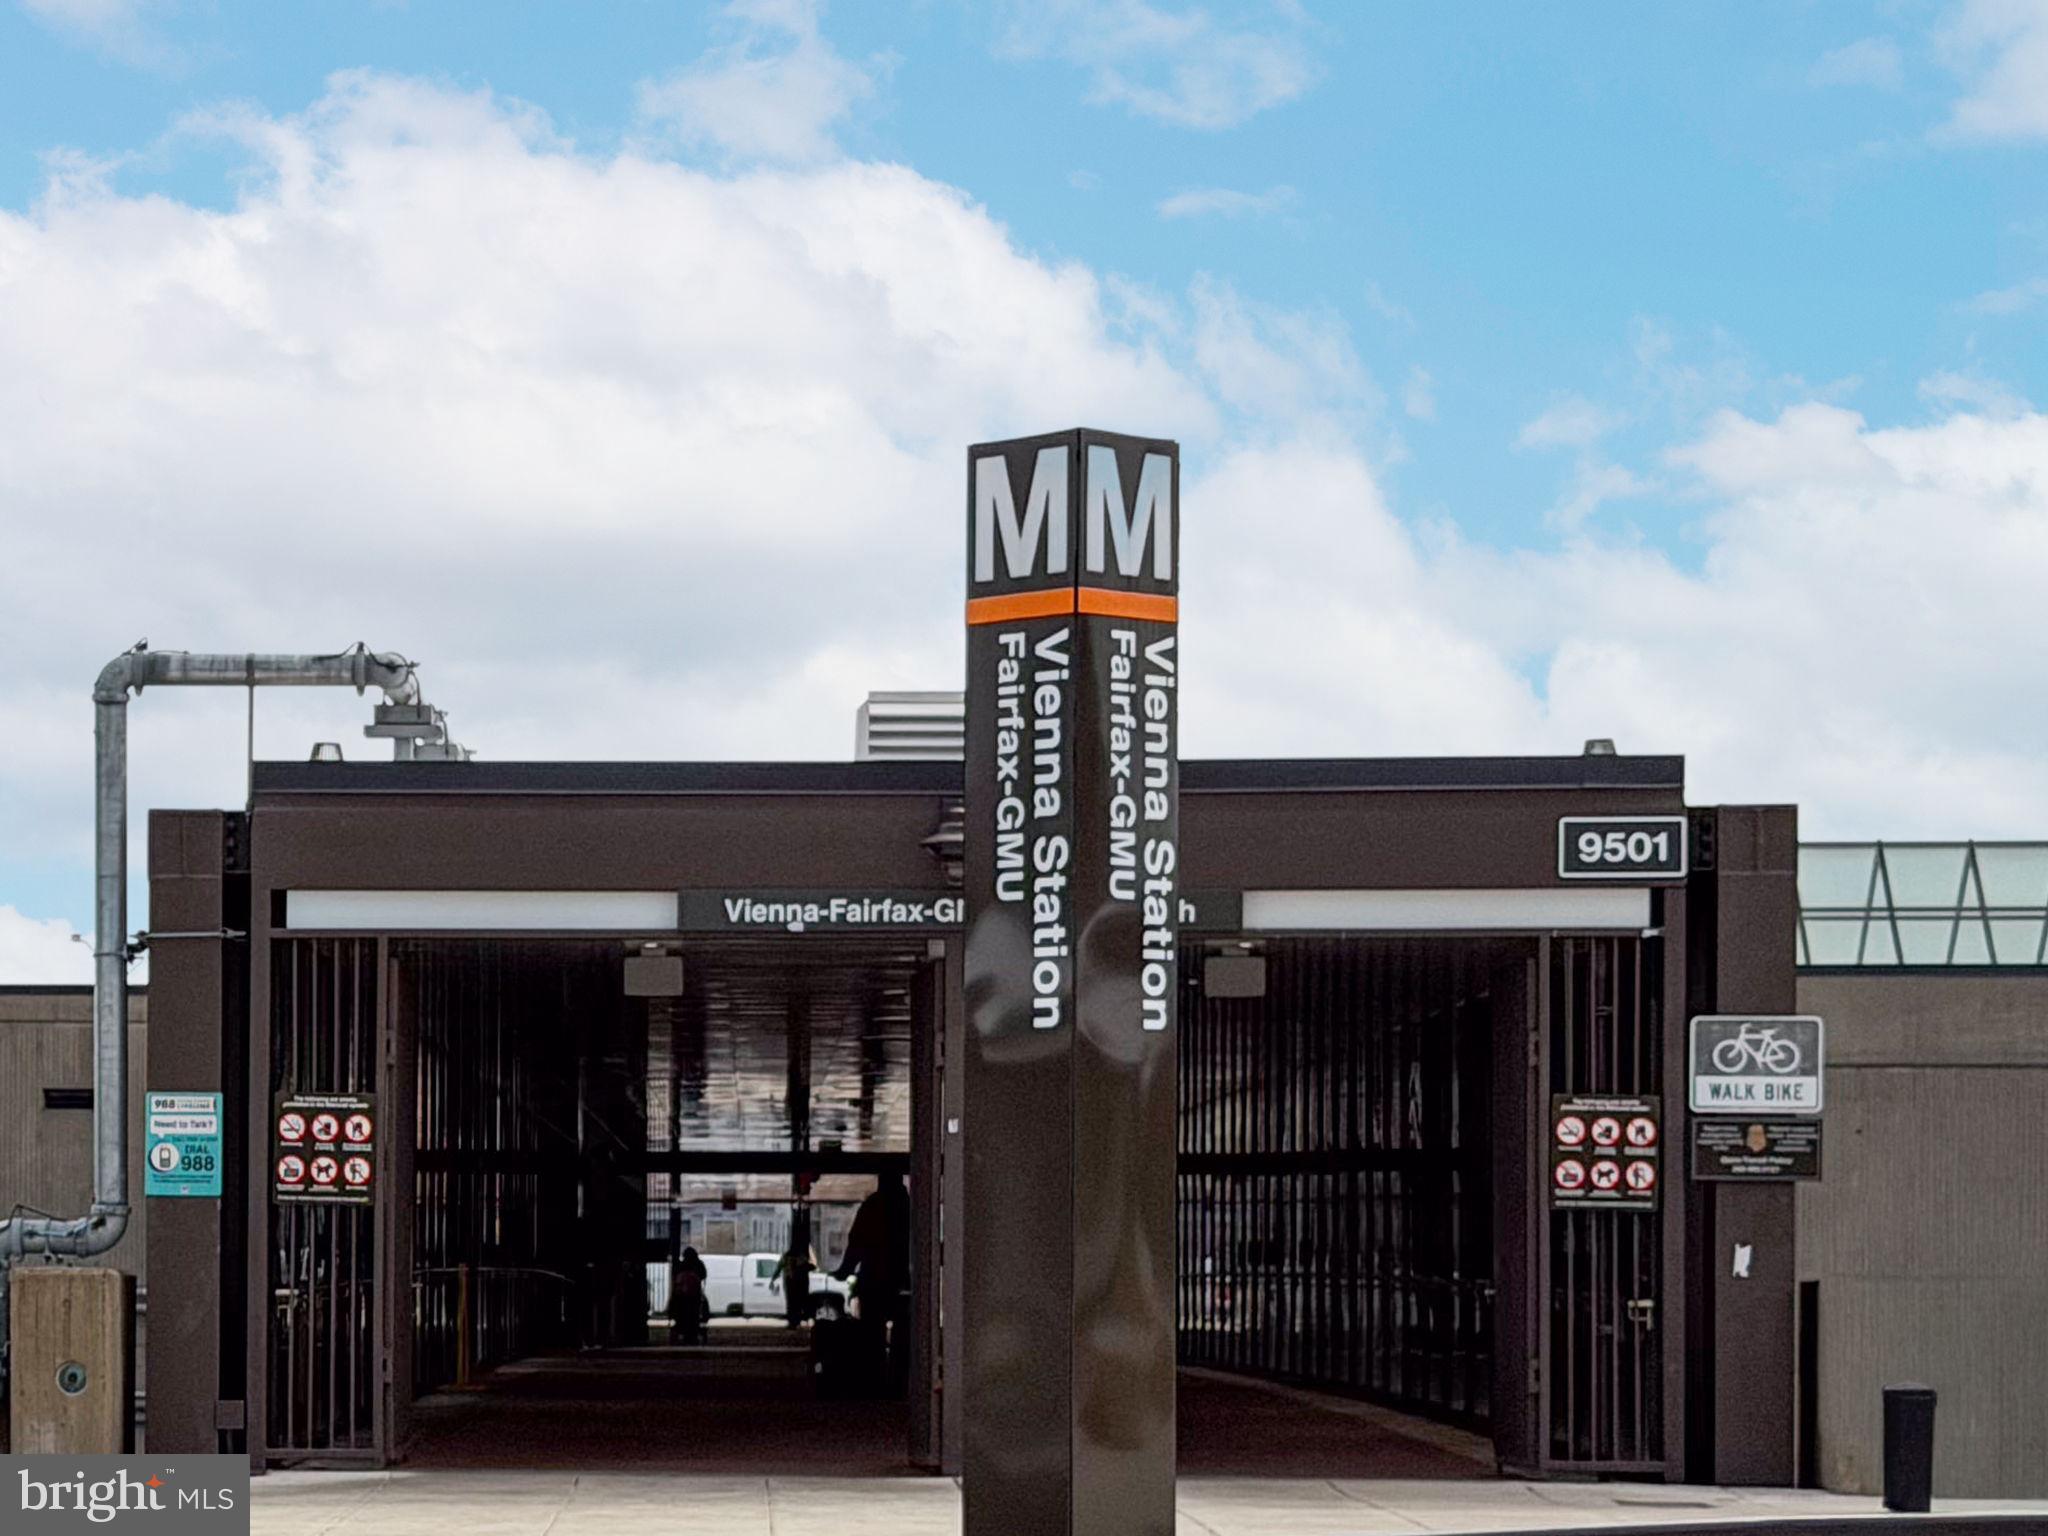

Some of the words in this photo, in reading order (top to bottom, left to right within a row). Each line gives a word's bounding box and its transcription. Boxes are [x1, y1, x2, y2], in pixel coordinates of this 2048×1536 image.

[974, 444, 1069, 583] M
[1086, 444, 1172, 581] M
[996, 631, 1026, 902] Fairfax-GMU
[1033, 627, 1070, 819] Vienna
[1109, 629, 1137, 900] Fairfax-GMU
[1143, 636, 1175, 821] Vienna
[1578, 831, 1668, 863] 9501
[1032, 835, 1069, 1029] Station
[1142, 839, 1176, 1031] Station
[181, 1155, 215, 1171] 988
[185, 1145, 209, 1154] DIAL
[1709, 1083, 1756, 1100] WALK
[1764, 1083, 1803, 1100] BIKE
